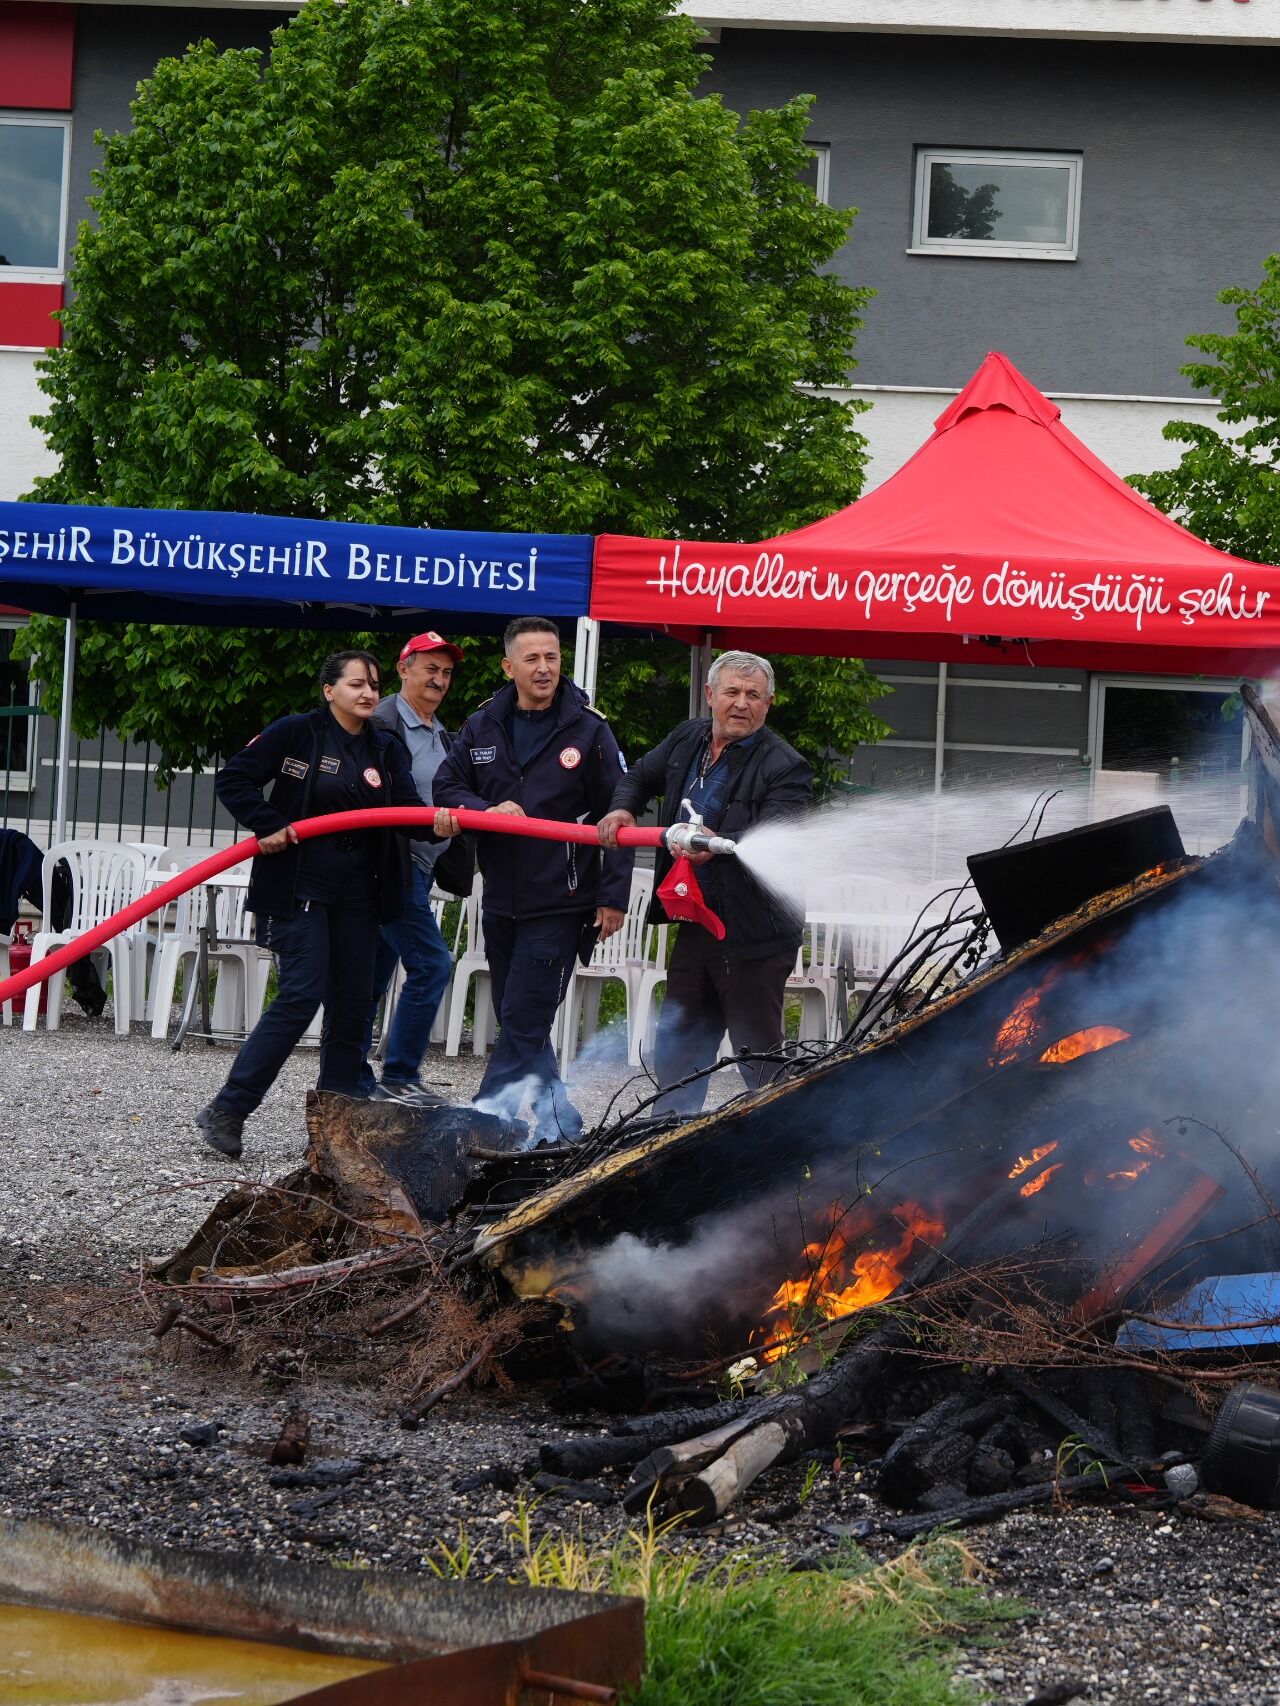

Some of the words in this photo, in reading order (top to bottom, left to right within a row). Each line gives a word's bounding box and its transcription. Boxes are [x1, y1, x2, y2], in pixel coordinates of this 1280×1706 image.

[111, 528, 331, 579] BÜYÜKŞEHİR
[348, 543, 538, 592] BELEDİYESİ
[646, 545, 849, 613] Hayallerin
[854, 565, 975, 622] gerçeğe
[982, 561, 1169, 631] dönüştüğü
[1178, 572, 1271, 625] şehir
